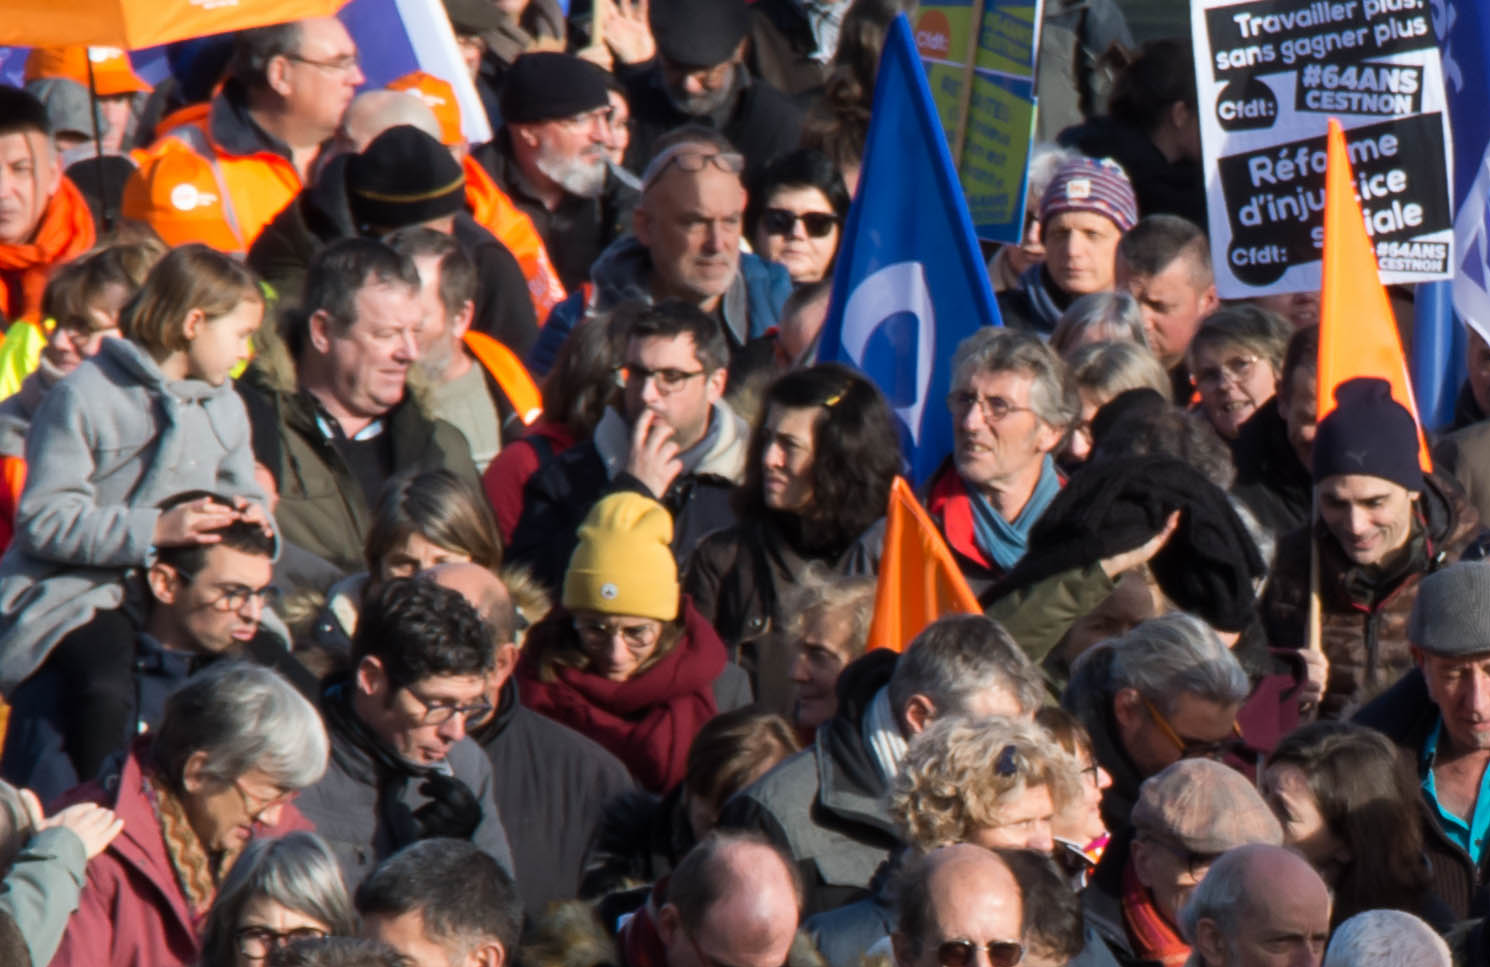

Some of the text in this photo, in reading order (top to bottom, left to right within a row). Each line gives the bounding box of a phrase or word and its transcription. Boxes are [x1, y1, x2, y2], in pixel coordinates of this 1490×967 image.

[1233, 1, 1356, 38] Travailler
[1215, 15, 1429, 71] sans gagner plus
[1302, 64, 1419, 95] #64ANS
[1217, 99, 1275, 120] Cfdt:
[1305, 90, 1413, 115] CESTNON
[1247, 133, 1399, 189] Réfome
[1237, 168, 1408, 227] d'injuice
[1231, 245, 1288, 266] Cfdt:
